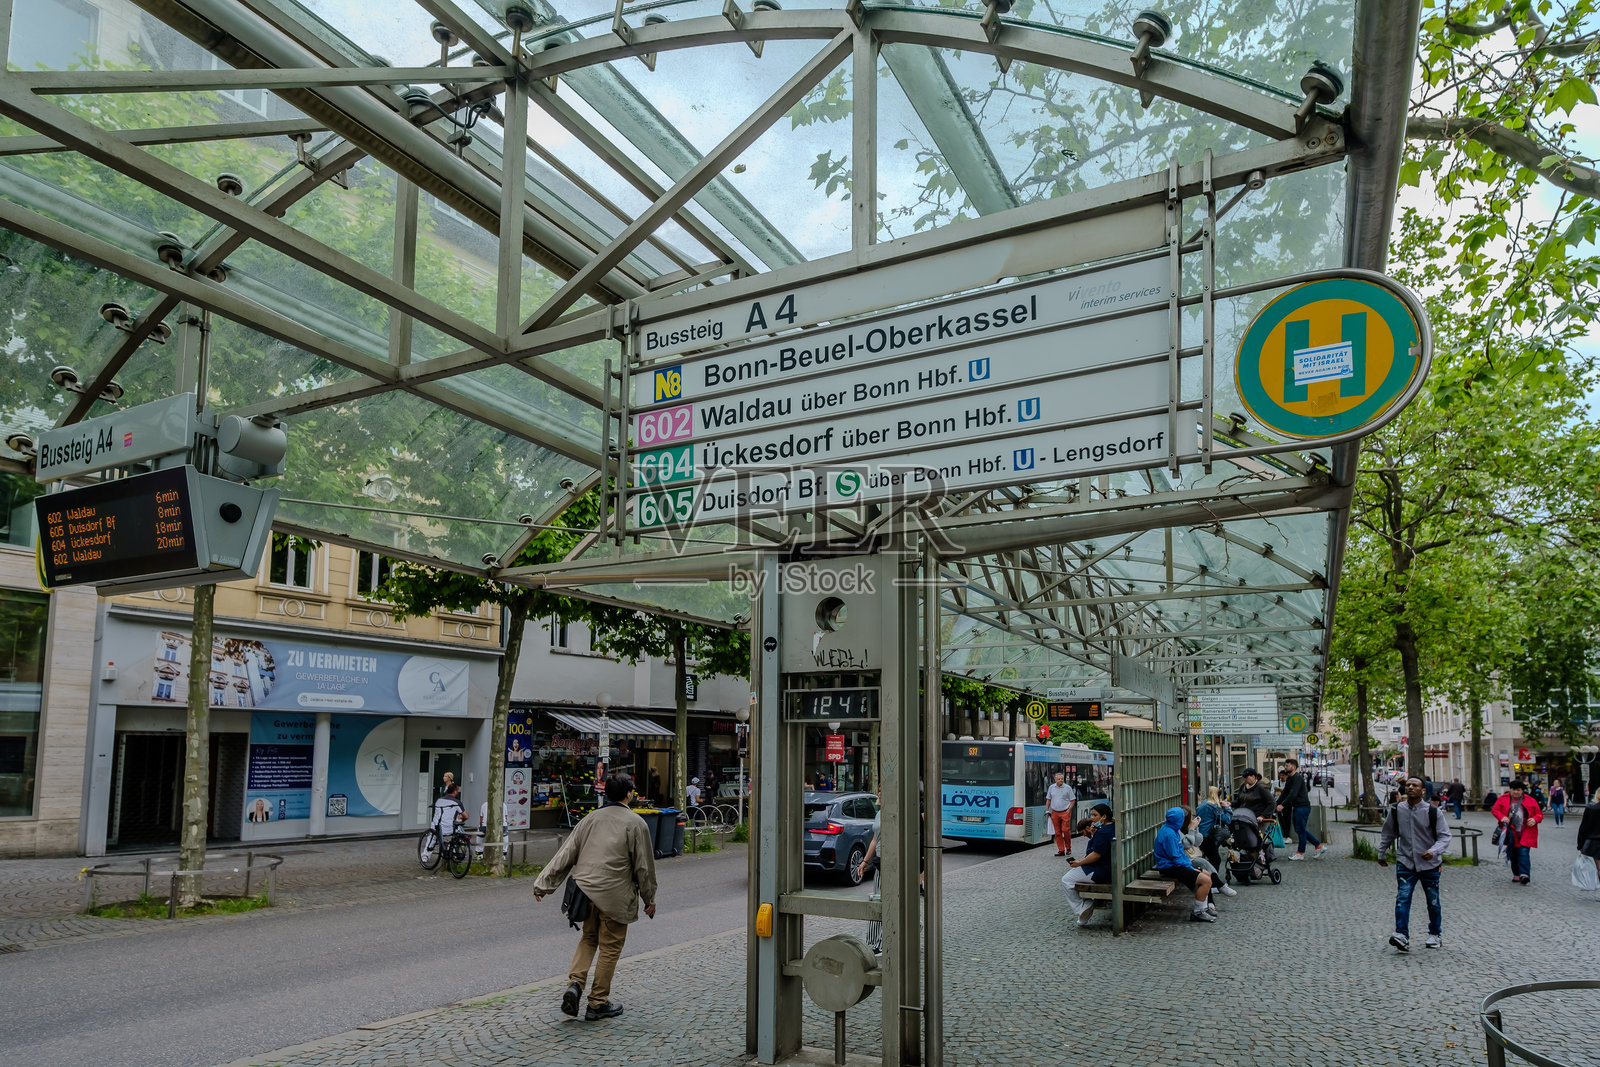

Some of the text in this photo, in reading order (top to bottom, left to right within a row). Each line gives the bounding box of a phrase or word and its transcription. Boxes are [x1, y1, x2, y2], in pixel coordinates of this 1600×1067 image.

[1081, 286, 1161, 310] interim services
[646, 319, 723, 350] Bussteig
[656, 295, 1037, 400] N8 Bonn-Beuel-Oberkassel
[1284, 312, 1366, 403] H
[1299, 351, 1348, 364] SOLIDARITÄT
[1318, 358, 1344, 366] ISRAEL
[640, 410, 691, 442] 602
[701, 398, 792, 429] Waldau
[802, 390, 846, 412] über
[854, 378, 909, 402] Bonn
[918, 365, 962, 390] Hbf.
[41, 426, 114, 469] Bussteig A4
[640, 448, 692, 482] 604
[703, 427, 834, 470] Ückesdorf
[842, 428, 889, 448] über
[898, 417, 956, 440] Bonn
[965, 404, 1012, 429] Hbf.
[640, 490, 693, 526] 605
[702, 482, 790, 512] Duisdorf
[798, 476, 827, 498] Bf.
[870, 471, 908, 488] über
[914, 464, 962, 482] Bonn
[968, 456, 1006, 476] Hbf.
[1054, 432, 1164, 463] Lengsdorf
[48, 512, 62, 524] 602
[66, 506, 96, 520] Waldau
[50, 526, 64, 538] 605
[68, 518, 103, 534] Duisdorf
[106, 516, 116, 530] Bf
[52, 539, 66, 552] 604
[54, 552, 68, 565] 602
[73, 549, 102, 562] Waldau
[288, 650, 377, 672] ZU VERMIETEN
[296, 672, 360, 684] GEWERBEFLÄCHE
[1032, 706, 1039, 715] H
[509, 724, 524, 735] 100
[1292, 718, 1301, 728] H
